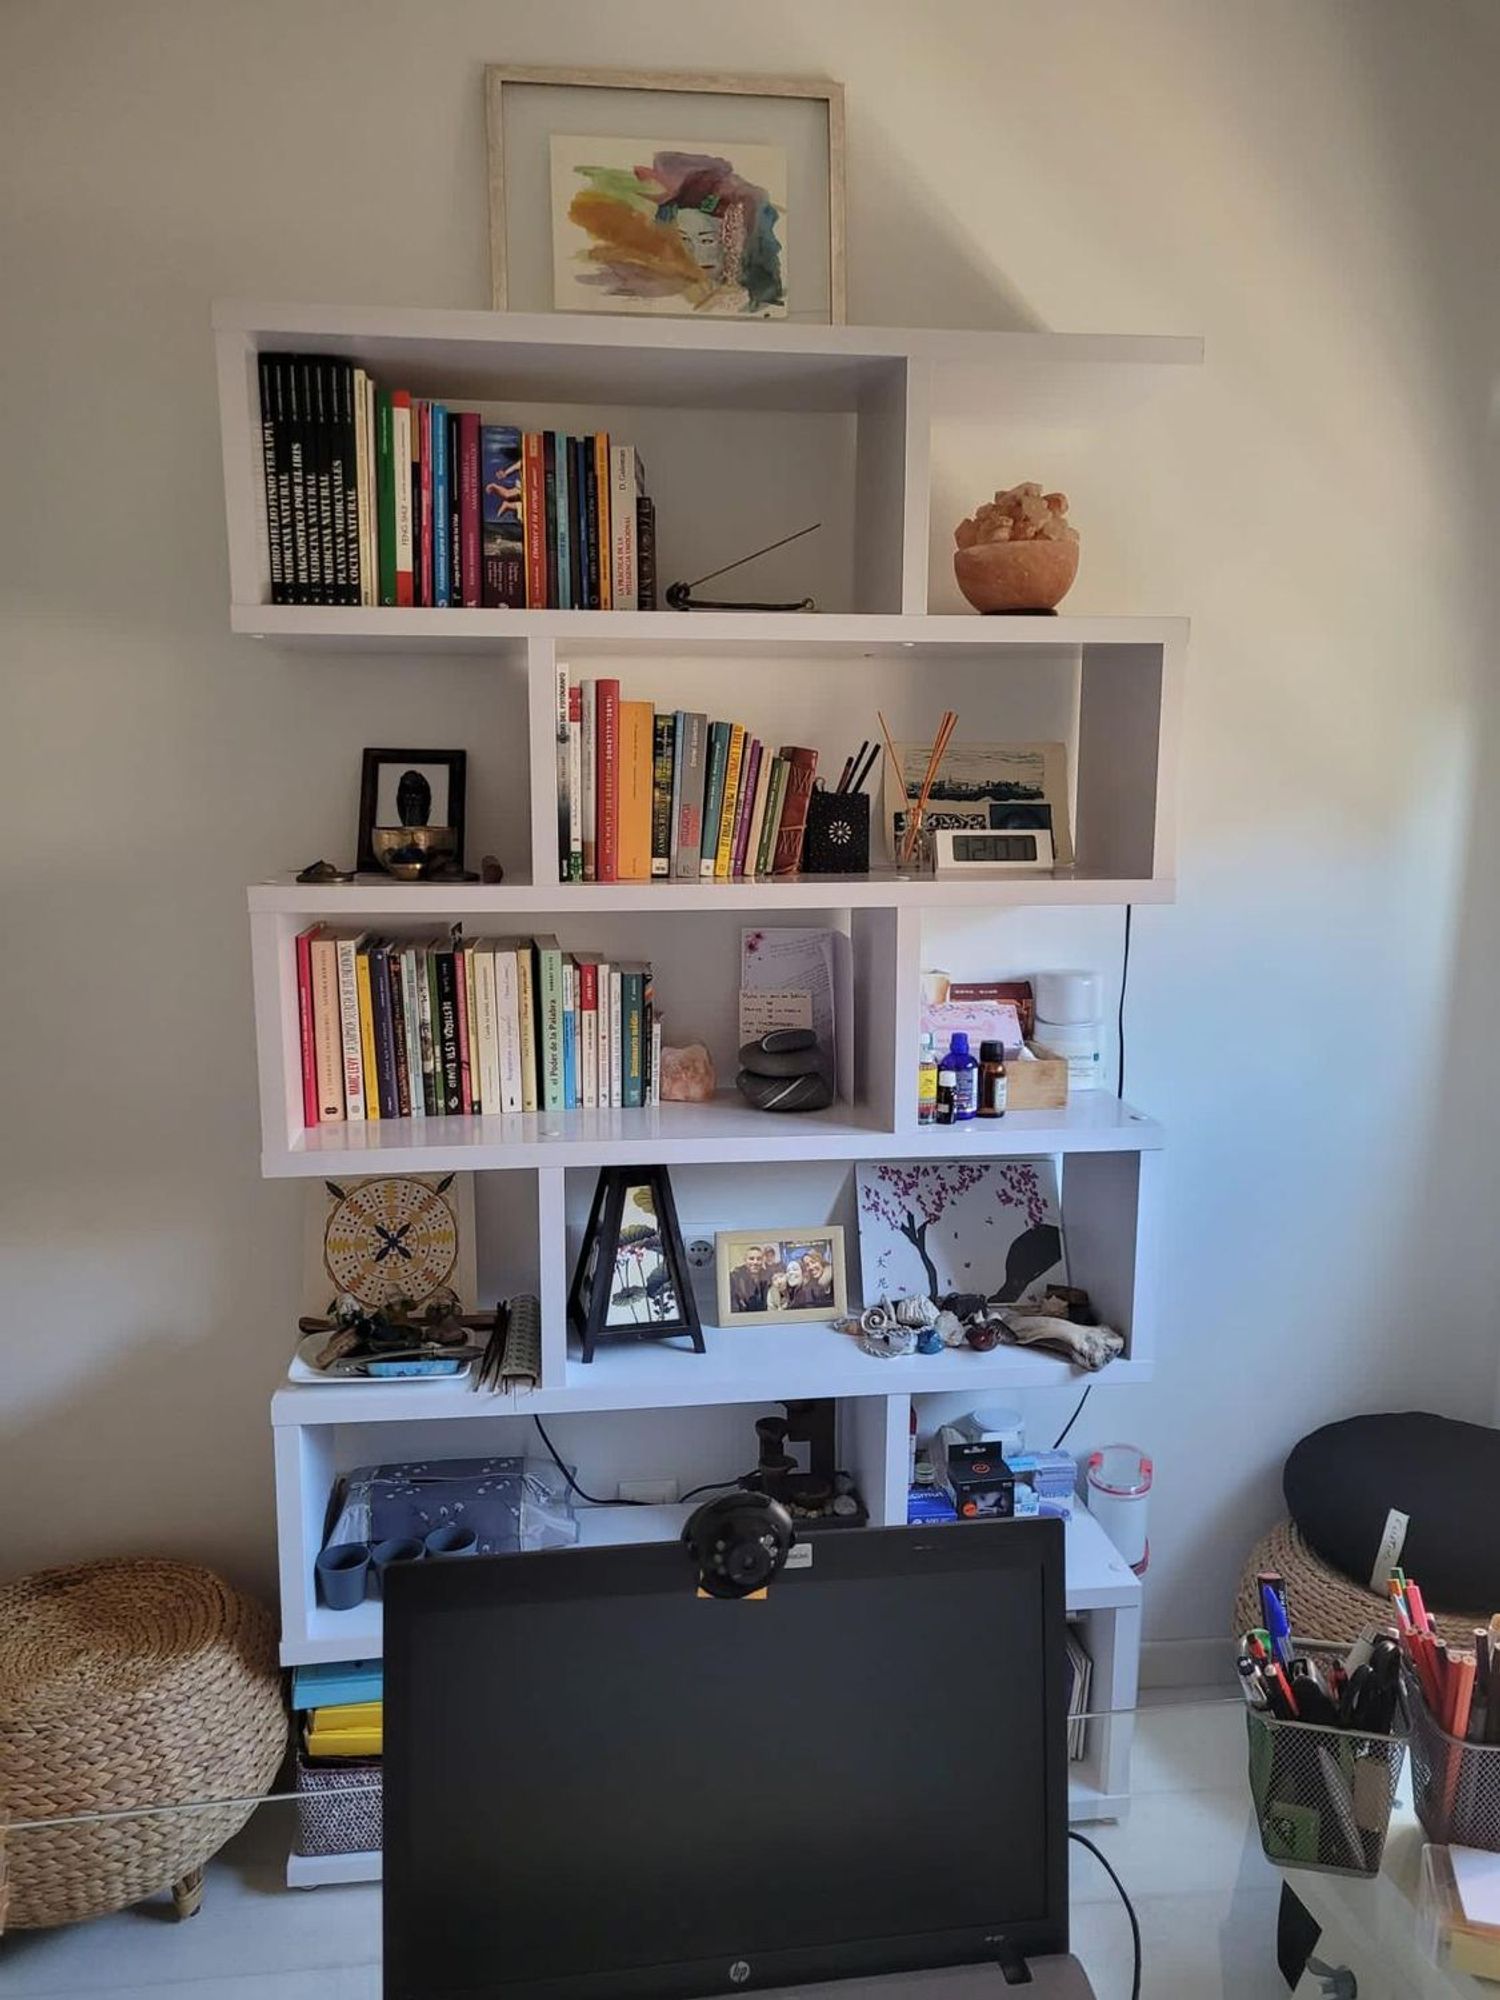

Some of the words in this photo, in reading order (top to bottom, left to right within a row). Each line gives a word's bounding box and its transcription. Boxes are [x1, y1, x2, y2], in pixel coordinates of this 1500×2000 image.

[292, 443, 302, 468] IRIS
[279, 472, 290, 524] NATURAL
[294, 485, 304, 508] POR
[306, 472, 317, 524] NATURAL
[319, 474, 331, 525] NATURAL
[333, 460, 344, 534] MEDICINALES
[347, 488, 357, 539] NATURAL
[283, 528, 295, 583] MEDICINA
[310, 528, 321, 583] MEDICINA
[323, 529, 334, 584] MEDICINA
[336, 537, 347, 584] PLANTAS
[349, 541, 359, 584] COCINA
[548, 999, 557, 1030] Palabra
[346, 1058, 359, 1074] LEVY
[347, 1075, 360, 1095] MARC
[550, 1053, 558, 1077] Poder
